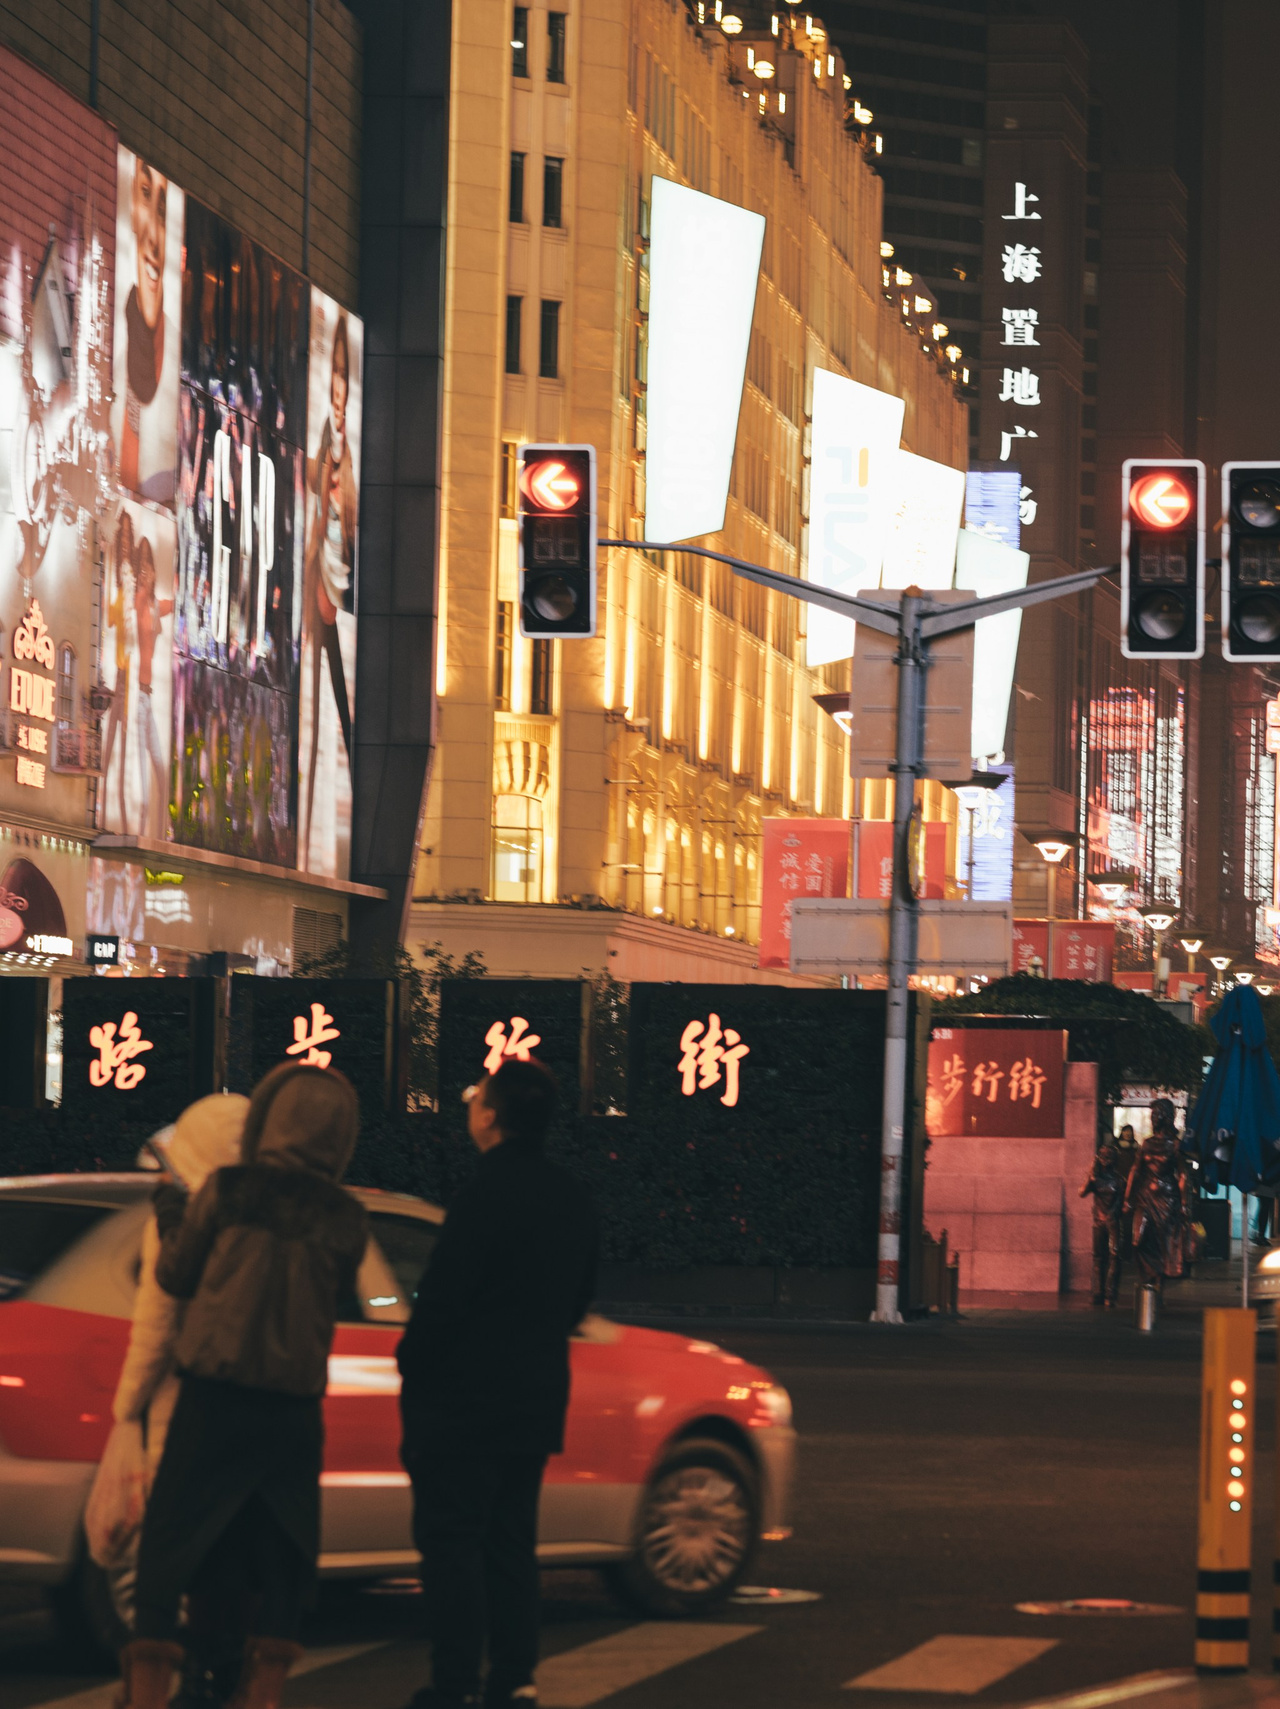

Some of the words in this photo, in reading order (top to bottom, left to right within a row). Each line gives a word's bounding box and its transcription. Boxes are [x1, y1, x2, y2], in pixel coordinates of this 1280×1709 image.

[211, 428, 276, 658] GAP
[822, 445, 870, 589] FILA
[939, 1053, 1047, 1109] 步行街
